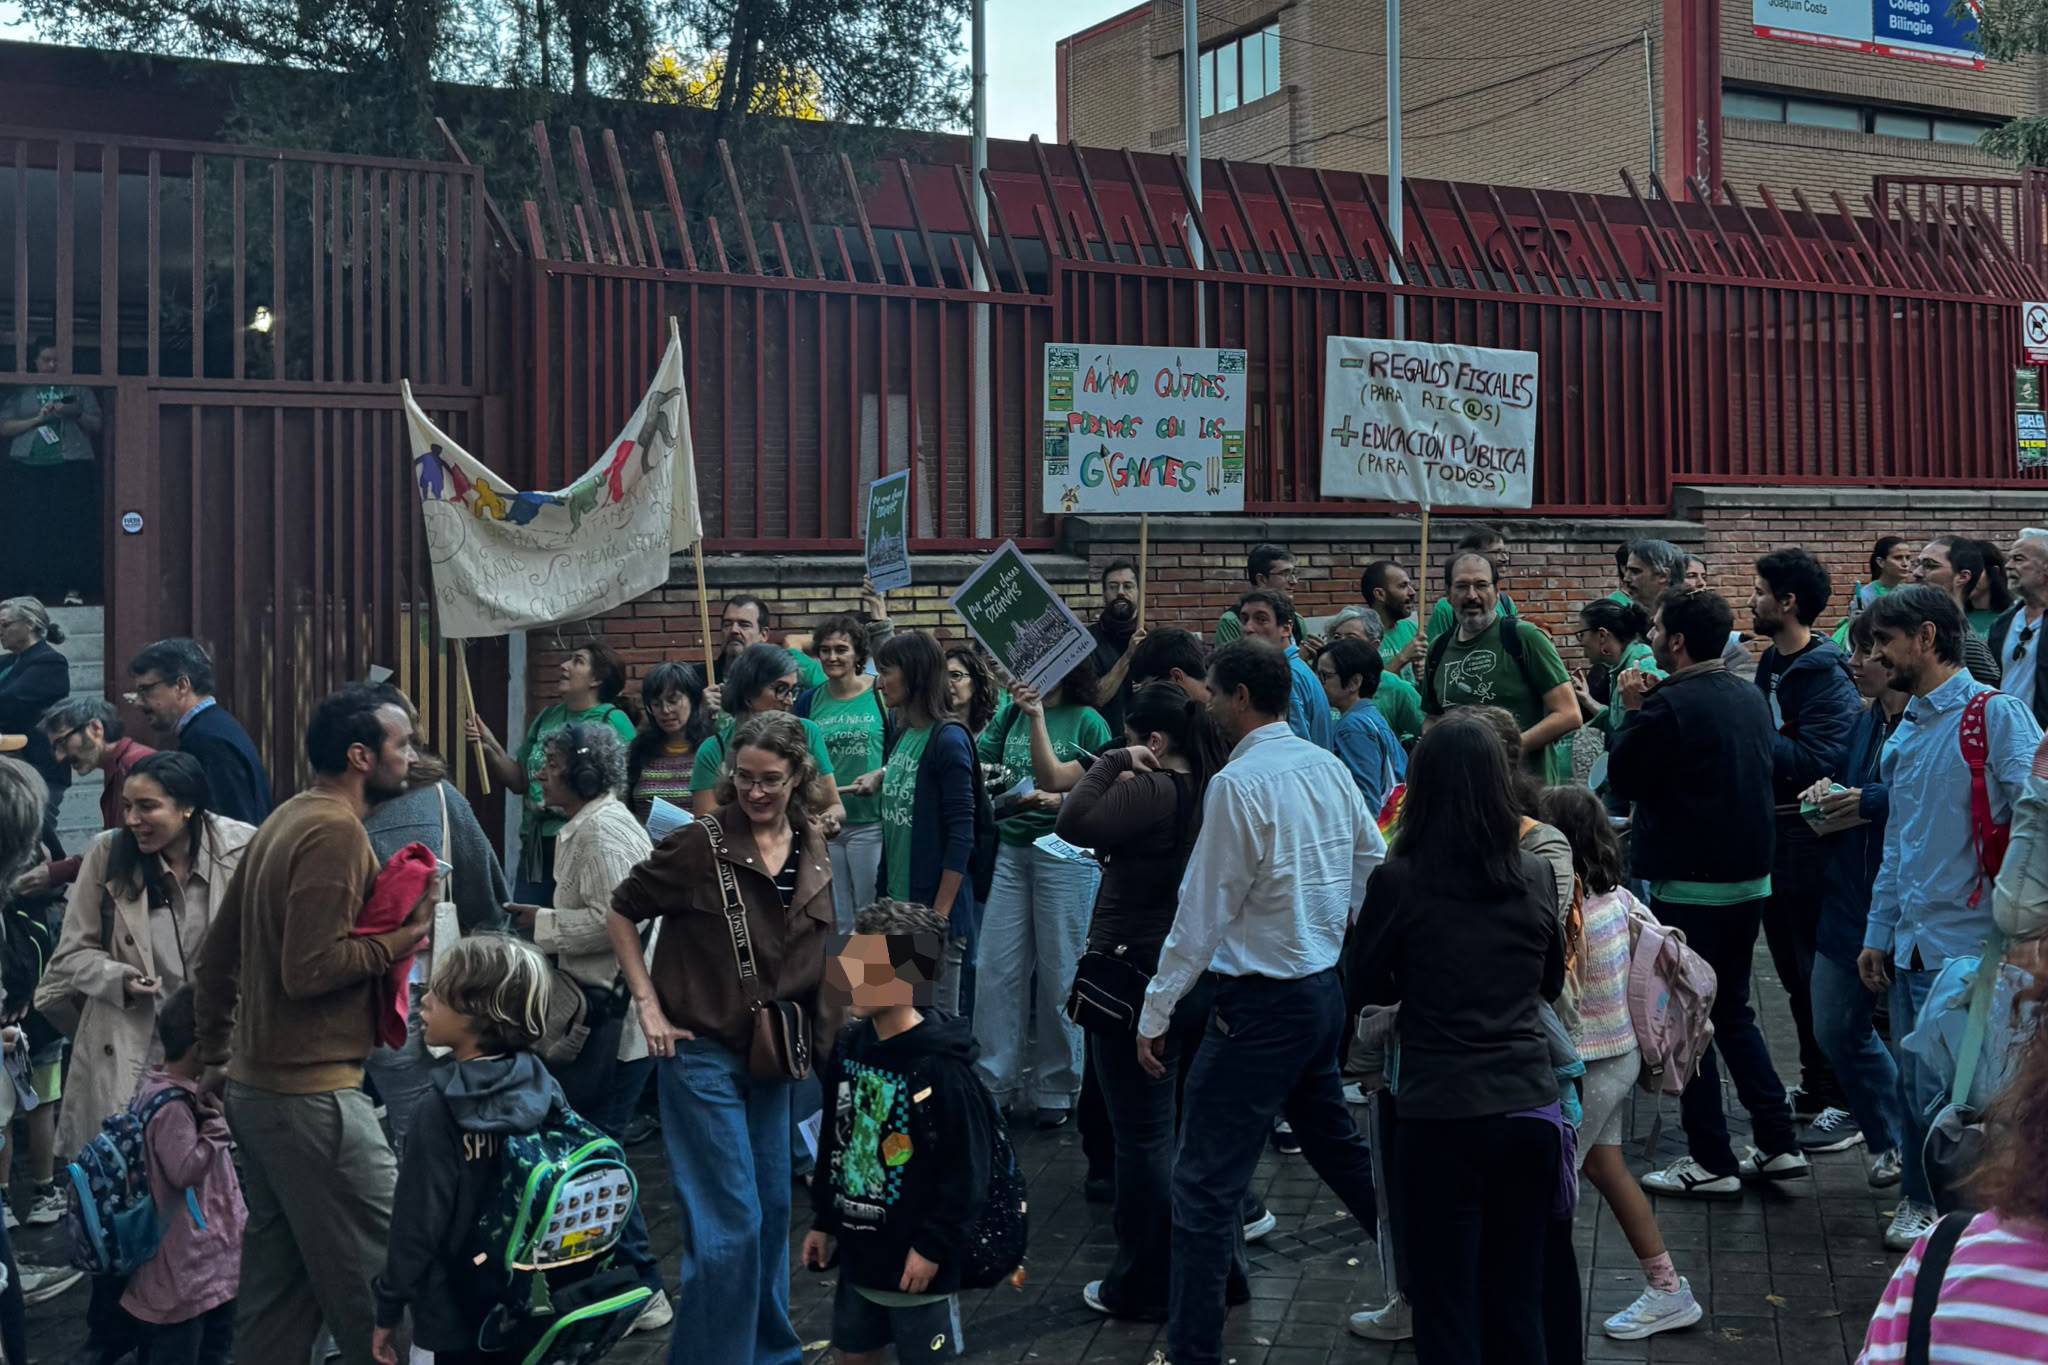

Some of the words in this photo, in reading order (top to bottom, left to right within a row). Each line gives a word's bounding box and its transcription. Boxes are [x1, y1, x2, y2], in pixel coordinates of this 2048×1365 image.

[1804, 0, 1828, 15] Costa
[1889, 0, 1930, 15] Colegio
[1889, 14, 1934, 36] Bilingüe
[1369, 351, 1454, 387] REGALOS
[1455, 362, 1533, 409] FISCALES
[1360, 383, 1403, 407] (PARA
[1422, 391, 1501, 427] RIC@S)
[1156, 415, 1185, 439] CON
[1199, 416, 1225, 440] LOS
[1361, 421, 1446, 460] EDUCACIÓN
[1451, 429, 1526, 474] PÚBLICA
[1358, 452, 1408, 476] (PARA
[1424, 461, 1506, 496] TOD@S)
